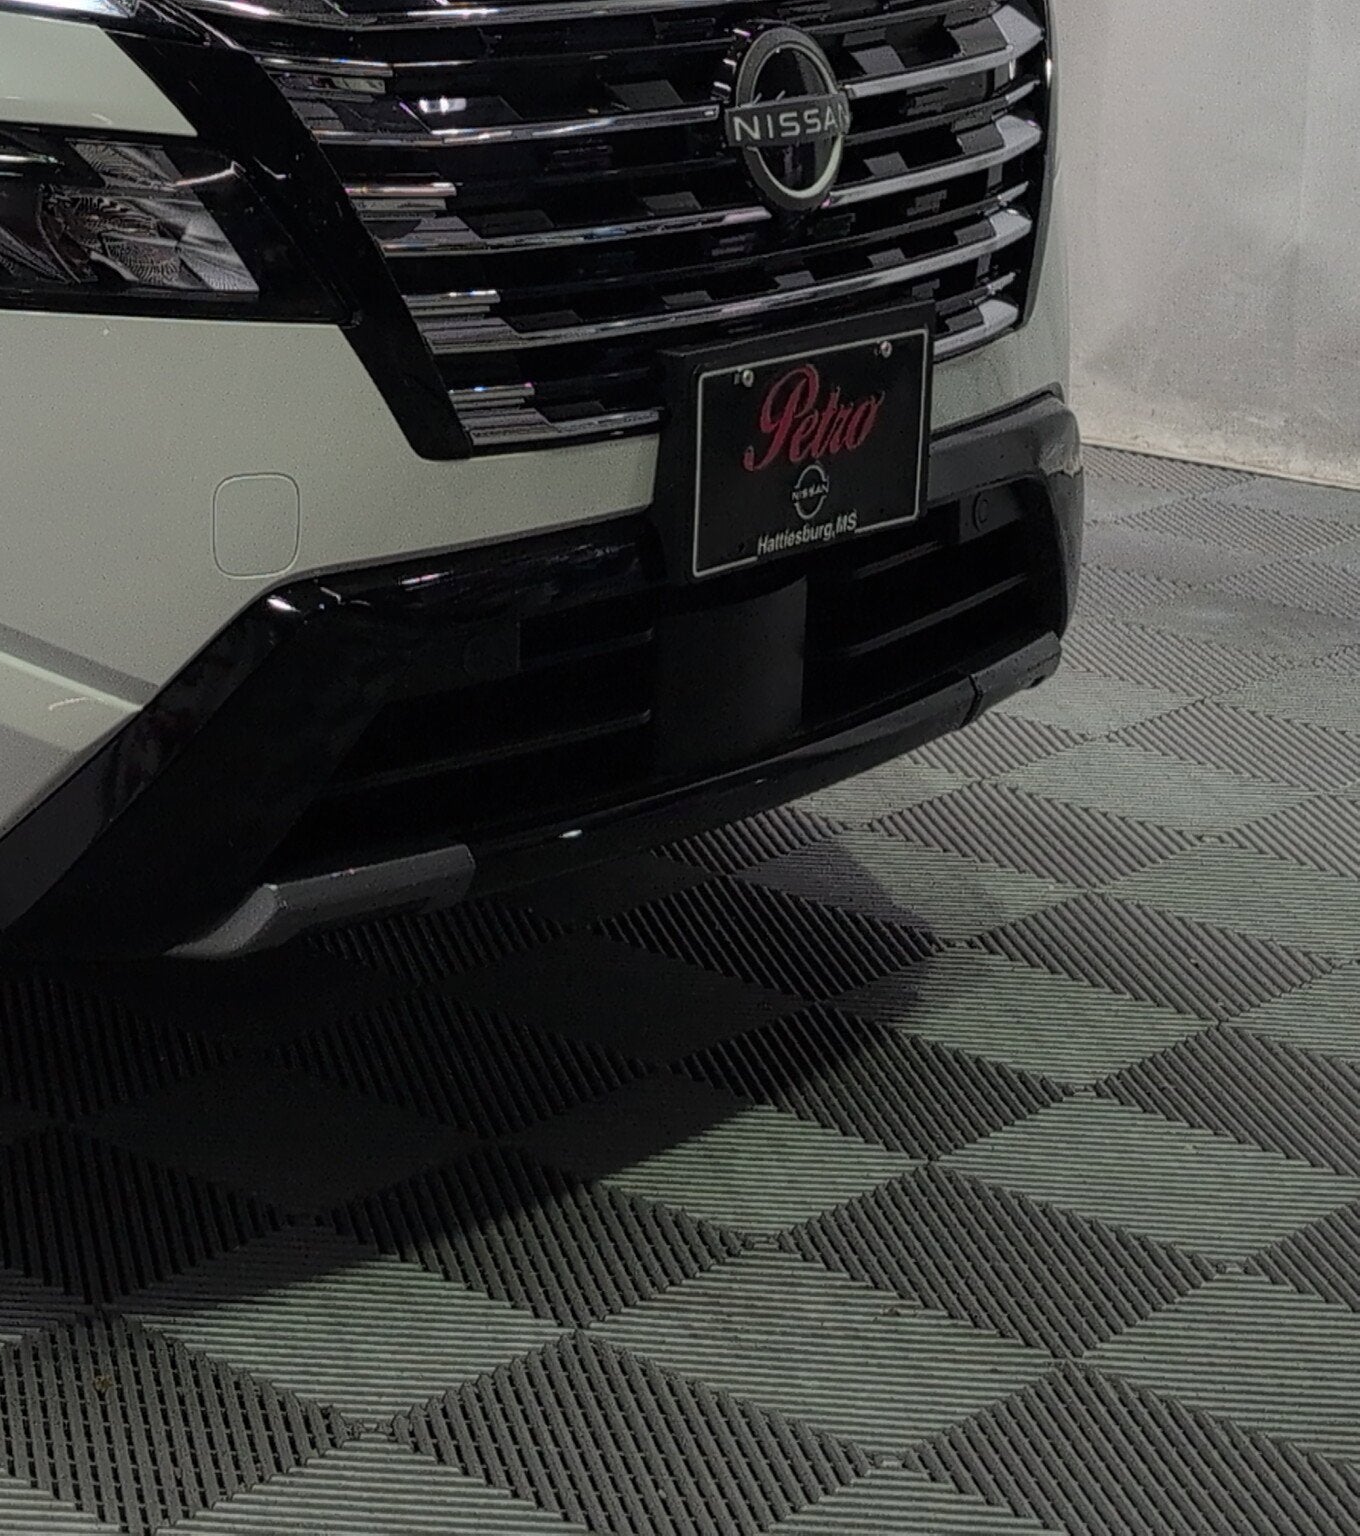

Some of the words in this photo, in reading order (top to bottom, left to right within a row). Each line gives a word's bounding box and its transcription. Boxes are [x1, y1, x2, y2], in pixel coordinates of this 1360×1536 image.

[732, 102, 851, 142] NISSAN
[742, 362, 886, 471] Petro
[791, 480, 830, 500] NISSAN
